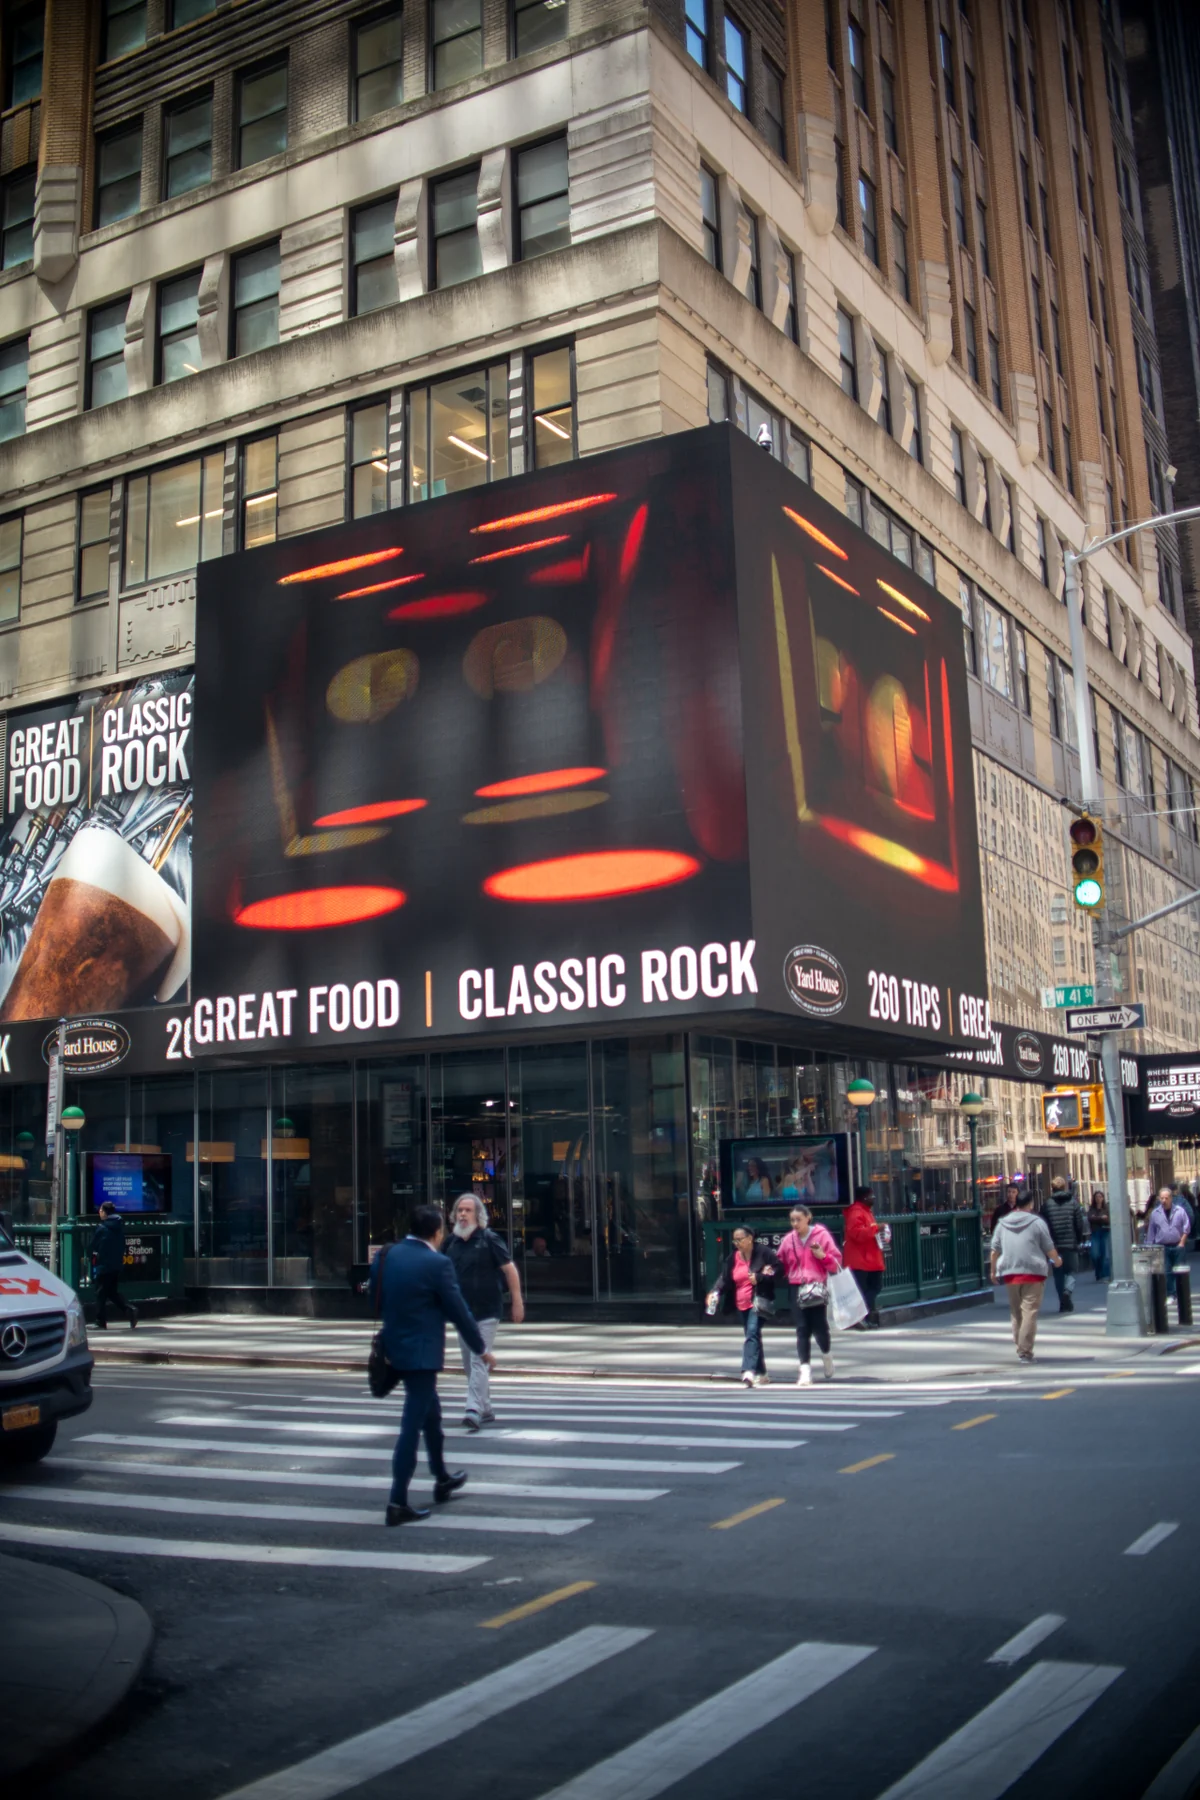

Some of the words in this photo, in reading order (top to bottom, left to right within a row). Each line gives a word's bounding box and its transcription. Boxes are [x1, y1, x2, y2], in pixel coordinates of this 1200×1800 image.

[103, 692, 192, 744] CLASSIC
[10, 716, 84, 768] GREAT
[101, 729, 190, 796] ROCK
[8, 758, 81, 814] FOOD
[194, 989, 298, 1044] GREAT
[309, 979, 400, 1034] FOOD
[458, 953, 626, 1020] CLASSIC
[641, 939, 759, 1004] ROCK
[794, 964, 815, 990] Yard
[814, 968, 840, 996] House
[1055, 989, 1065, 1005] W
[1069, 988, 1082, 1004] 41
[867, 969, 901, 1023] 260
[902, 978, 941, 1031] TAPS
[959, 993, 991, 1040] GREA
[1076, 1014, 1099, 1026] ONE
[1109, 1011, 1132, 1023] WAY
[83, 1036, 117, 1054] House
[1052, 1043, 1070, 1077] 260
[1069, 1047, 1090, 1080] TAPS
[1120, 1057, 1139, 1088] FOOD
[1146, 1068, 1169, 1076] WHERE
[128, 1245, 153, 1256] Station
